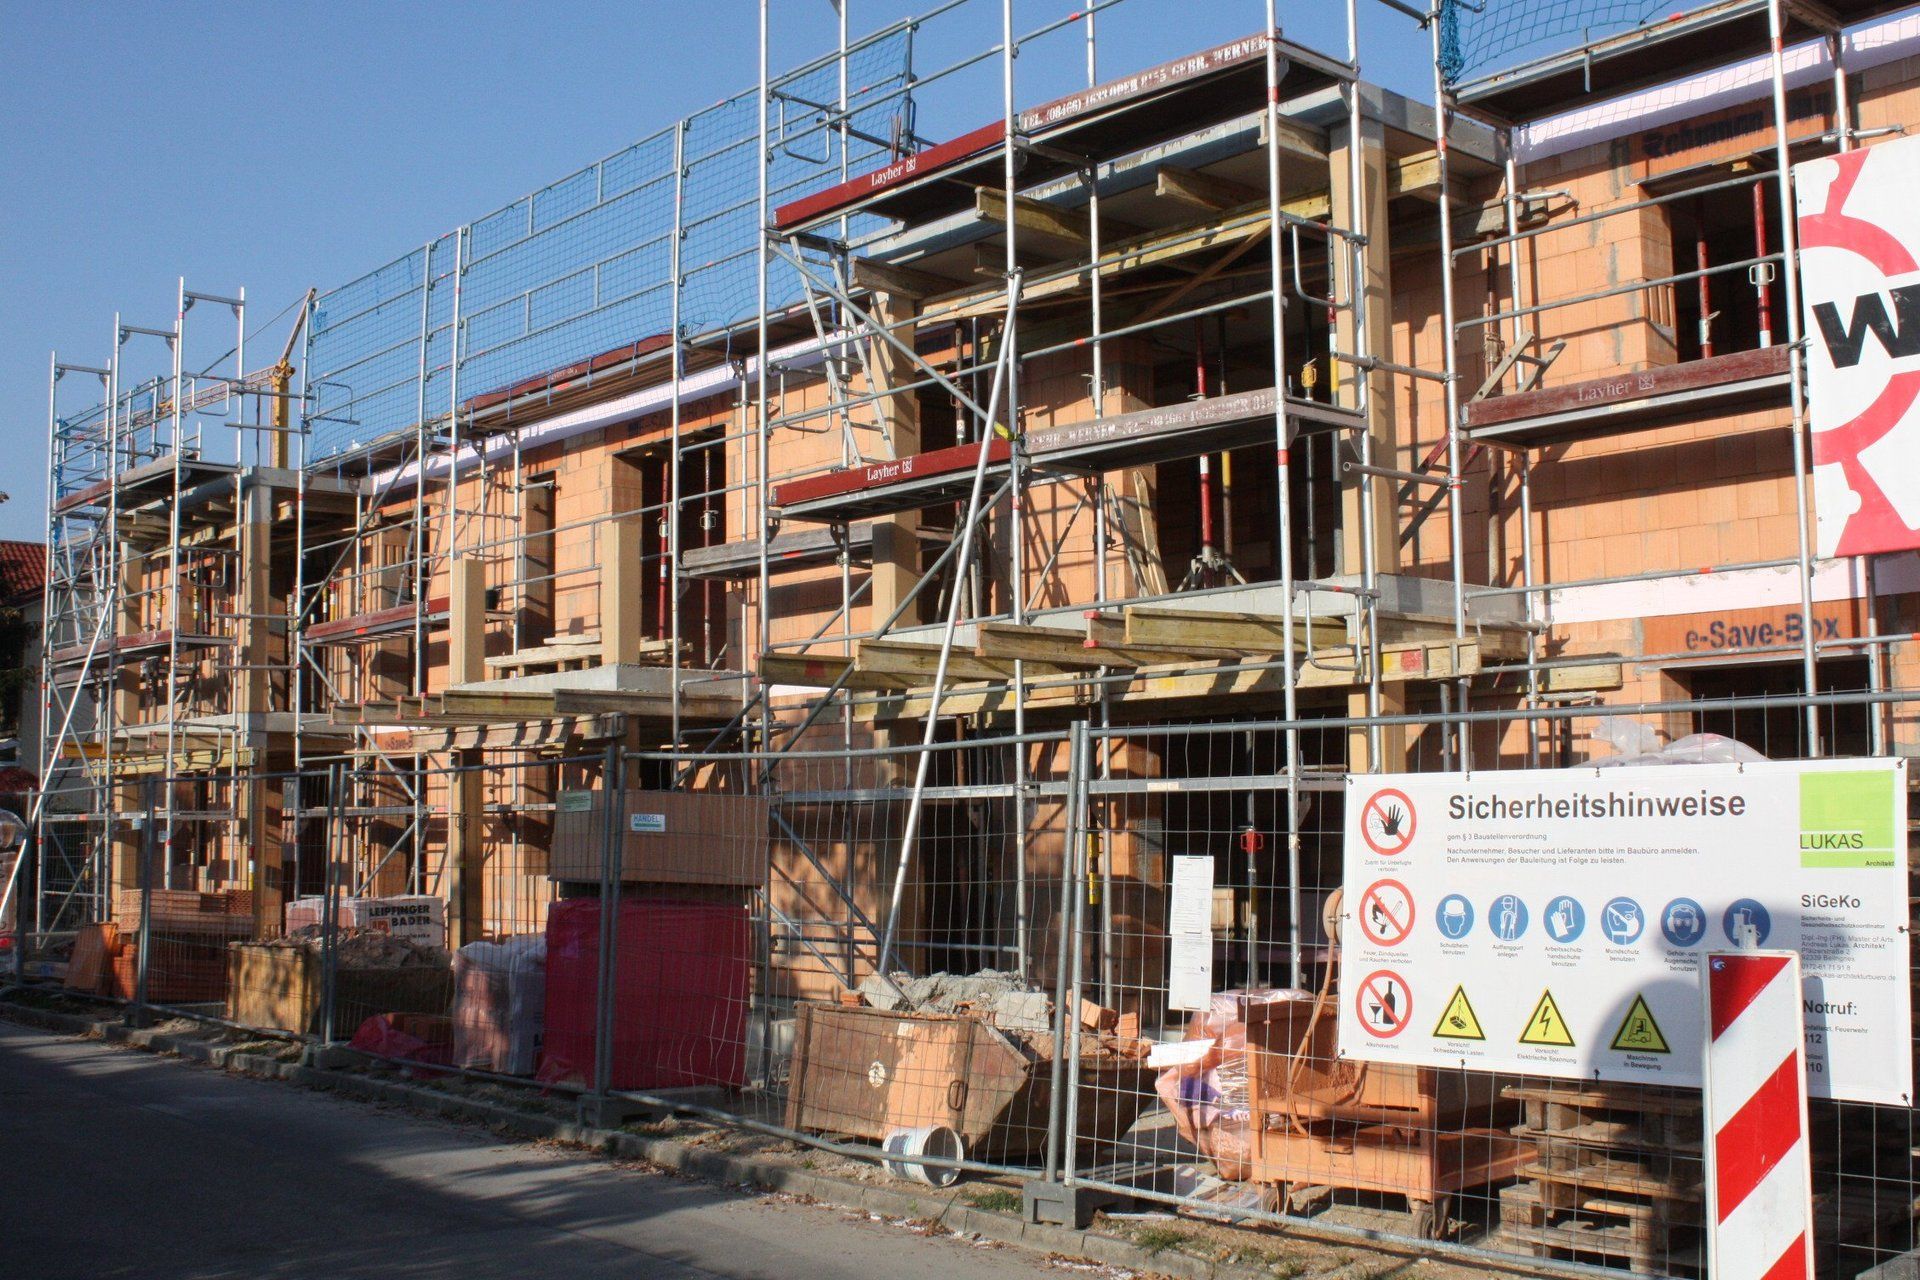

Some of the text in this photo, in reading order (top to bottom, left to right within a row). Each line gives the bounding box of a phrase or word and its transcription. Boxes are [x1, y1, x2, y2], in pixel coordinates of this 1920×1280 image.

[1023, 113, 1043, 129] TEL.
[871, 165, 903, 186] Layher
[1577, 380, 1633, 401] Layher
[867, 465, 899, 481] Layher
[1449, 789, 1746, 820] Sicherheitshinweise
[1473, 832, 1547, 841] Baustellenverordnung
[1800, 833, 1864, 849] LUKAS
[1508, 847, 1540, 855] Besucher
[1541, 847, 1556, 855] und
[1557, 847, 1597, 855] Lieferanten
[1598, 846, 1615, 855] bitte
[1616, 847, 1626, 855] im
[1627, 846, 1659, 855] Baubüro
[1660, 846, 1700, 855] anmelden.
[1461, 856, 1506, 865] Anweisungen
[1520, 856, 1556, 865] Bauleitung
[1568, 855, 1584, 864] Folge
[1801, 894, 1861, 908] SiGeKo
[369, 904, 430, 917] LEIPFINGER
[391, 916, 431, 927] BADER
[1664, 957, 1698, 965] Augenschu
[1803, 1000, 1857, 1016] Notruf:
[1834, 1025, 1868, 1034] Feuerwehr
[1805, 1033, 1822, 1044] 112
[1433, 1046, 1465, 1055] Schwebende
[1517, 1053, 1577, 1065] Elektrische Spannung
[1626, 1053, 1658, 1062] Maschinen
[1630, 1061, 1662, 1071] Bewegung
